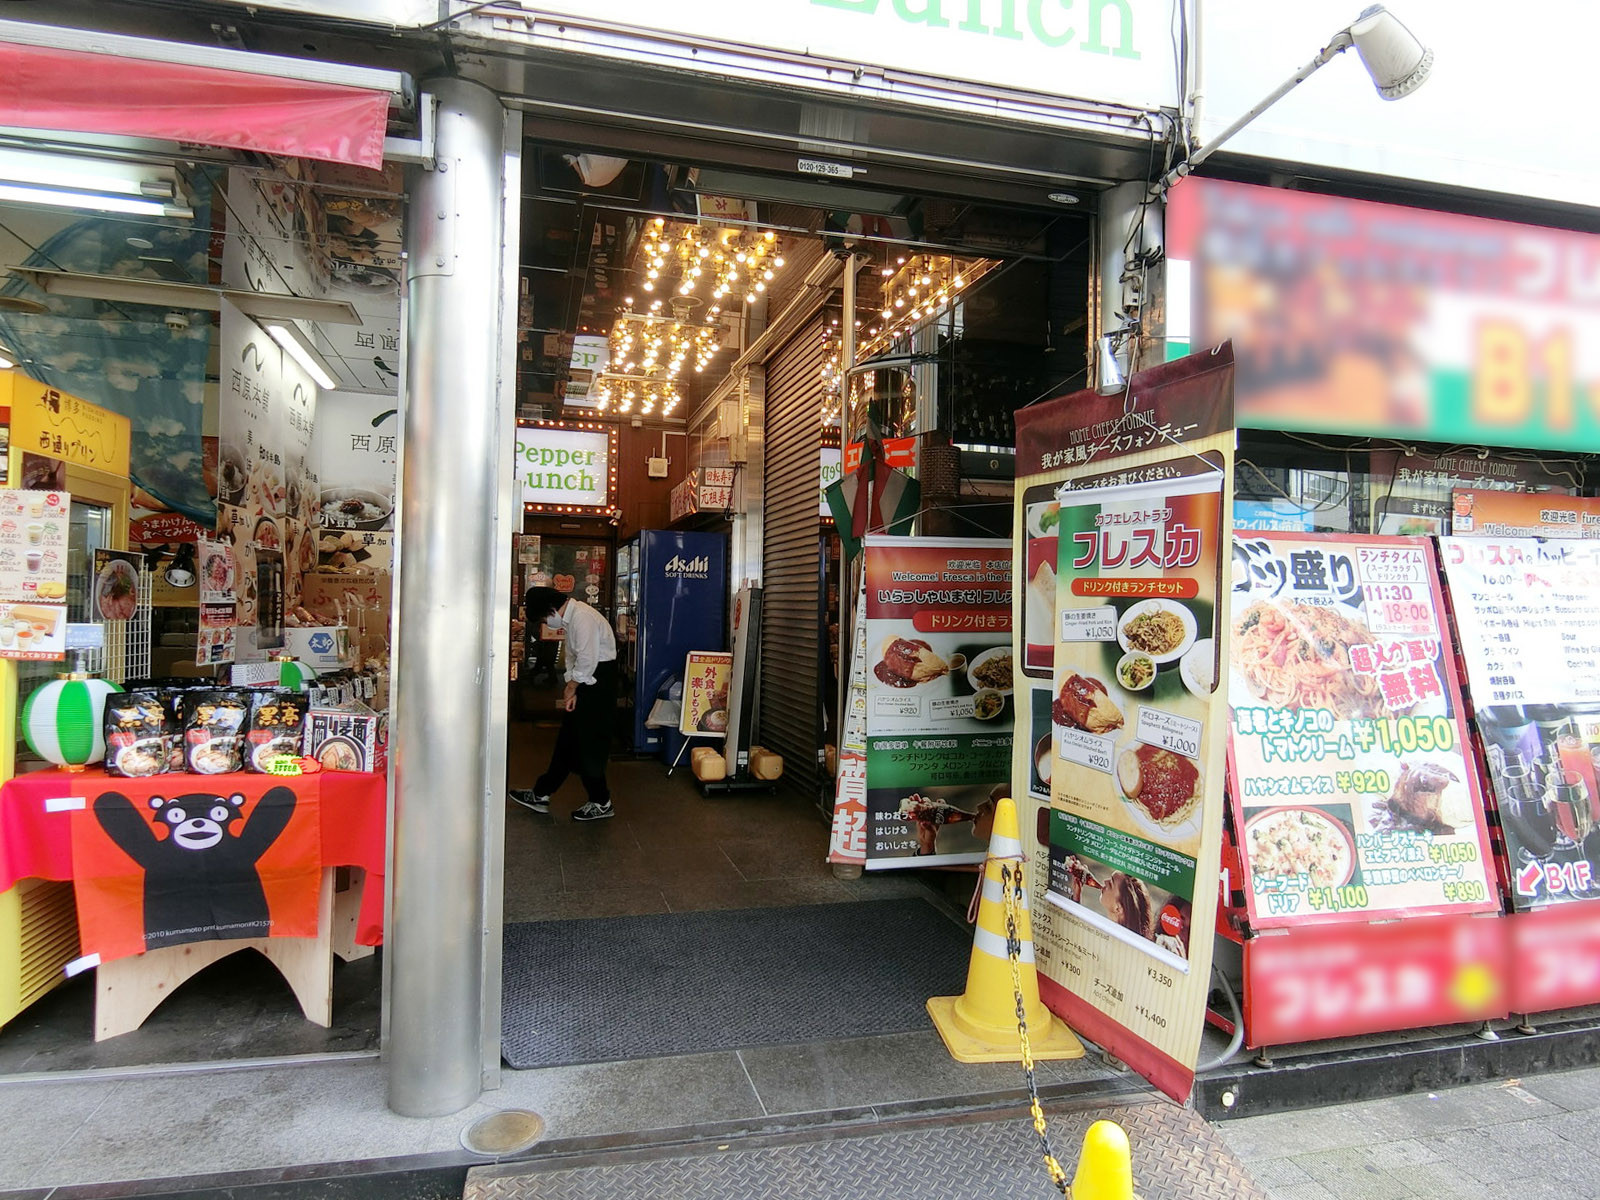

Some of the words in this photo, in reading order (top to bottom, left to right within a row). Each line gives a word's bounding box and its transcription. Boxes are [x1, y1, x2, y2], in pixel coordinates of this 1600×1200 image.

[810, 0, 1141, 60] unch
[799, 162, 839, 175] 0120-129-365
[523, 469, 596, 491] unch
[1095, 508, 1173, 527] カフェレストラン
[1072, 523, 1202, 569] フレスカ
[665, 555, 709, 572] Asahi
[1360, 550, 1422, 564] ランチタイム
[892, 570, 939, 582] Welcome!
[943, 571, 975, 582] Fresca
[986, 571, 1002, 582] the
[1082, 580, 1184, 595] ドリンク付きランチセット
[1366, 585, 1413, 601] 11:30
[931, 615, 1012, 628] ドリンク付きラ
[1086, 627, 1113, 640] ¥1,050
[1380, 663, 1441, 707] 無料
[1162, 735, 1196, 754] ¥1,000
[1352, 716, 1454, 757] ¥1,050
[1261, 734, 1355, 763] トマトクリーム
[1089, 754, 1109, 768] ¥920
[1244, 776, 1334, 796] ハヤシオムライス
[1336, 769, 1390, 794] ¥920
[1429, 842, 1477, 865] ¥1,050
[1253, 873, 1309, 895] シーフード
[1544, 862, 1590, 892] B1F
[1308, 885, 1368, 912] ¥1,100
[1443, 880, 1484, 902] ¥890
[1268, 894, 1300, 914] ドリア
[1147, 967, 1172, 988] ¥3,350
